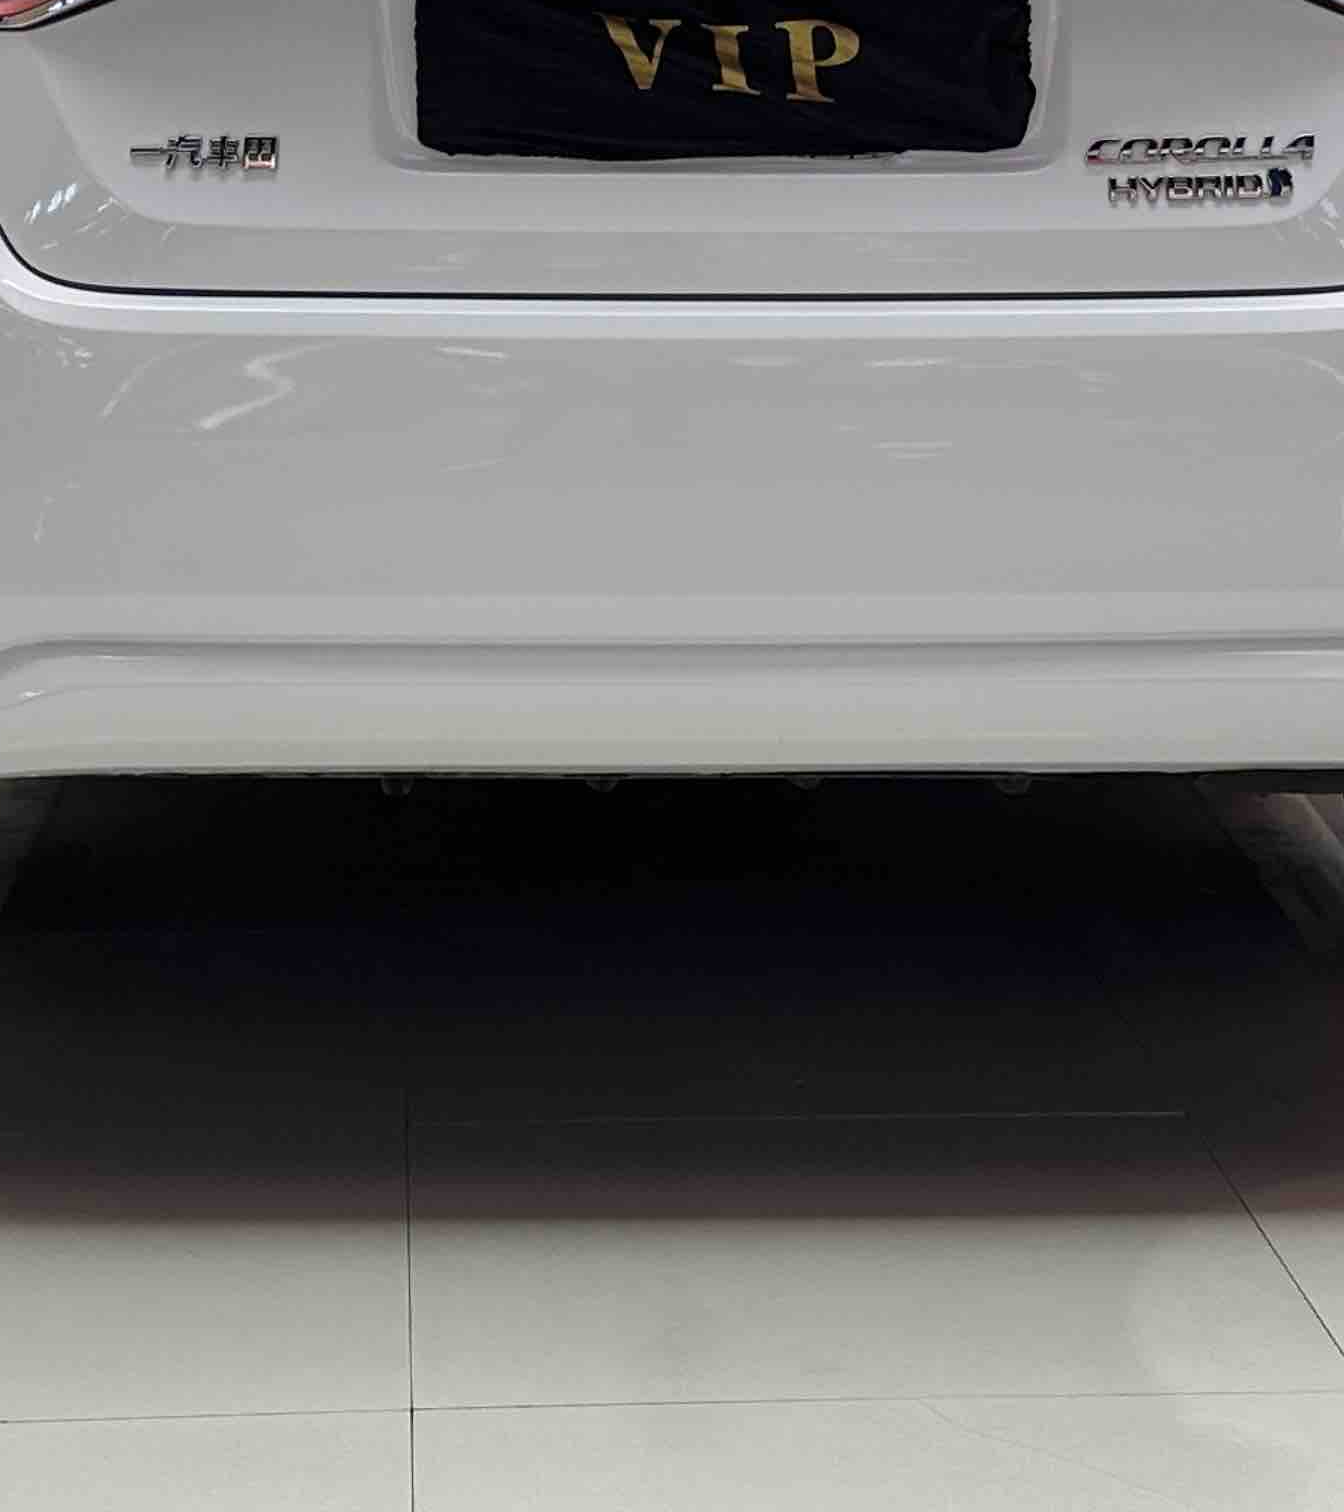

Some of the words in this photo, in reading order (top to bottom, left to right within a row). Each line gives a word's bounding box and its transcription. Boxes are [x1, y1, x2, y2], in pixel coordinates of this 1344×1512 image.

[594, 11, 862, 104] VIP
[1085, 134, 1316, 167] COROLLA
[1107, 174, 1265, 202] HYBRID
